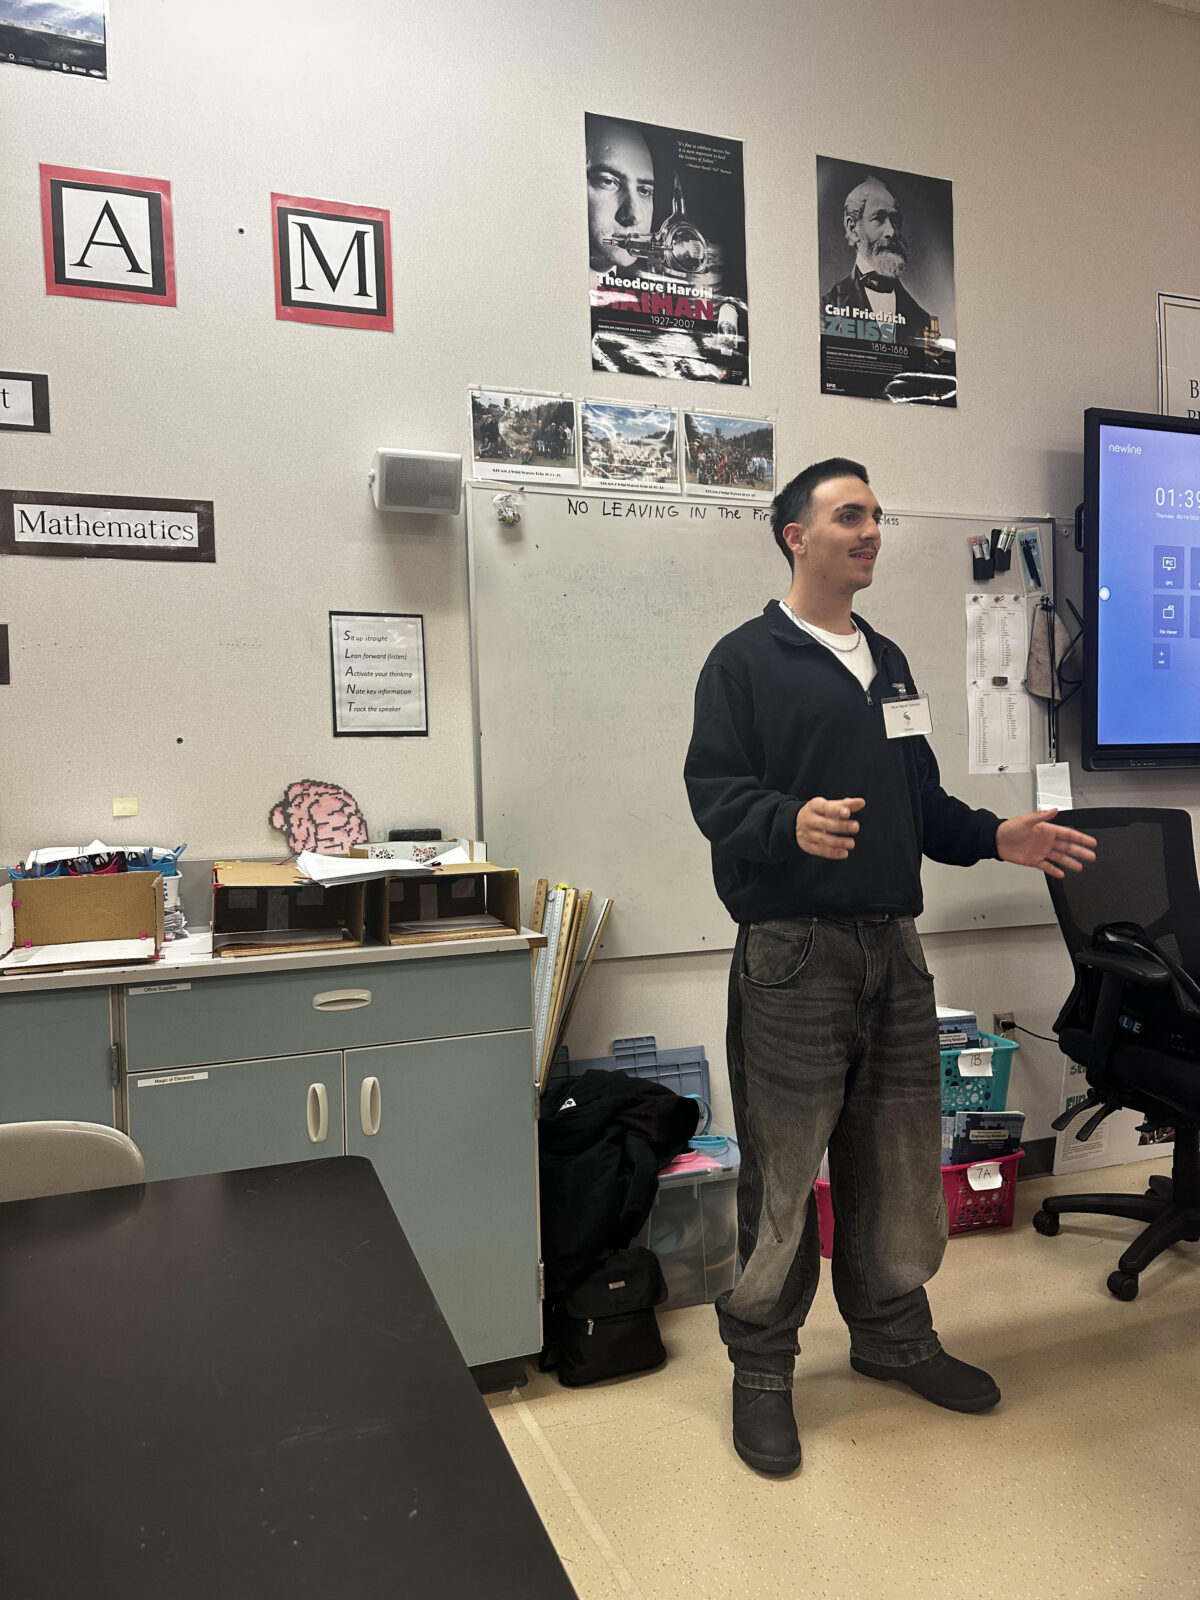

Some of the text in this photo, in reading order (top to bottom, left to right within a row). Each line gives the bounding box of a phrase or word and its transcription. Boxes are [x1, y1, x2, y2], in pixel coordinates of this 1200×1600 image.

[69, 200, 151, 275] A
[291, 221, 374, 298] M
[598, 272, 664, 293] Theodore
[825, 304, 906, 324] Carl Friedrich
[651, 316, 696, 328] 1927-2007
[824, 316, 894, 344] ZEISS
[872, 342, 909, 355] 1816-1888
[1108, 444, 1142, 455] newline
[568, 498, 588, 516] NO
[602, 500, 680, 519] LEAVING
[690, 506, 707, 520] IN
[718, 506, 742, 520] The
[18, 509, 194, 542] Mathematics
[344, 630, 355, 641] Sit
[345, 648, 361, 659] Lean
[345, 666, 374, 677] Activate
[346, 684, 366, 695] Note
[347, 702, 366, 712] Track
[976, 1167, 991, 1179] 7A
